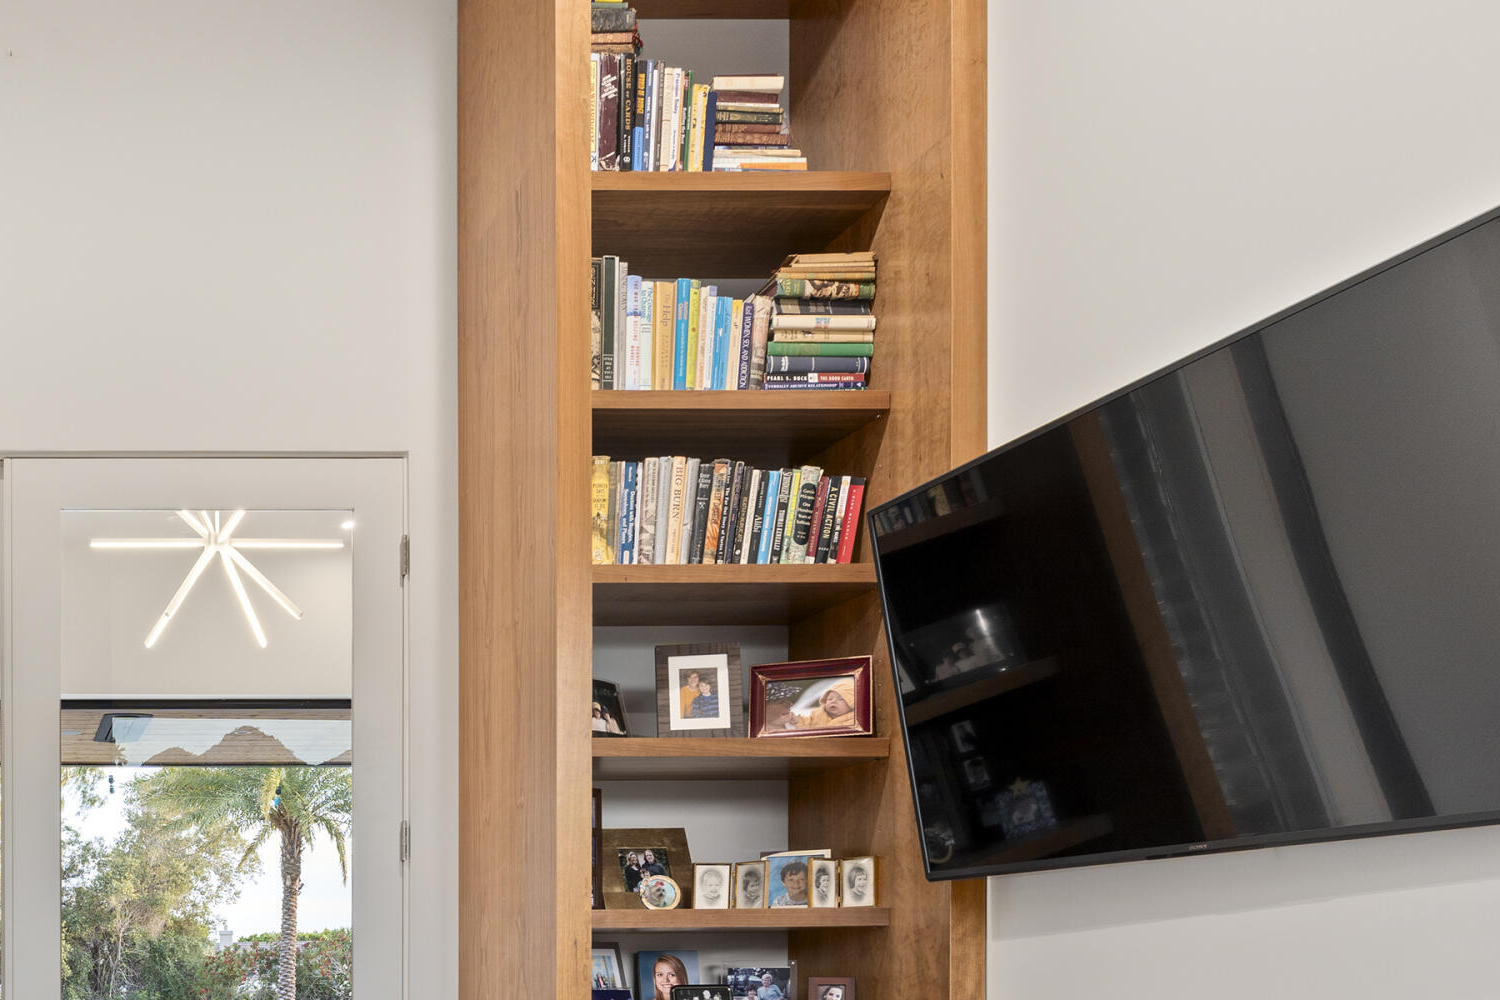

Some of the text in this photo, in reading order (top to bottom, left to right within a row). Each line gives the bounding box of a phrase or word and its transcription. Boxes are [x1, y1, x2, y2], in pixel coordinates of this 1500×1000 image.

[660, 305, 671, 327] Help
[673, 466, 683, 486] BIG
[672, 489, 682, 519] BURN
[827, 493, 837, 512] CIVIL
[753, 514, 762, 533] Alibi
[822, 514, 834, 539] ACTION
